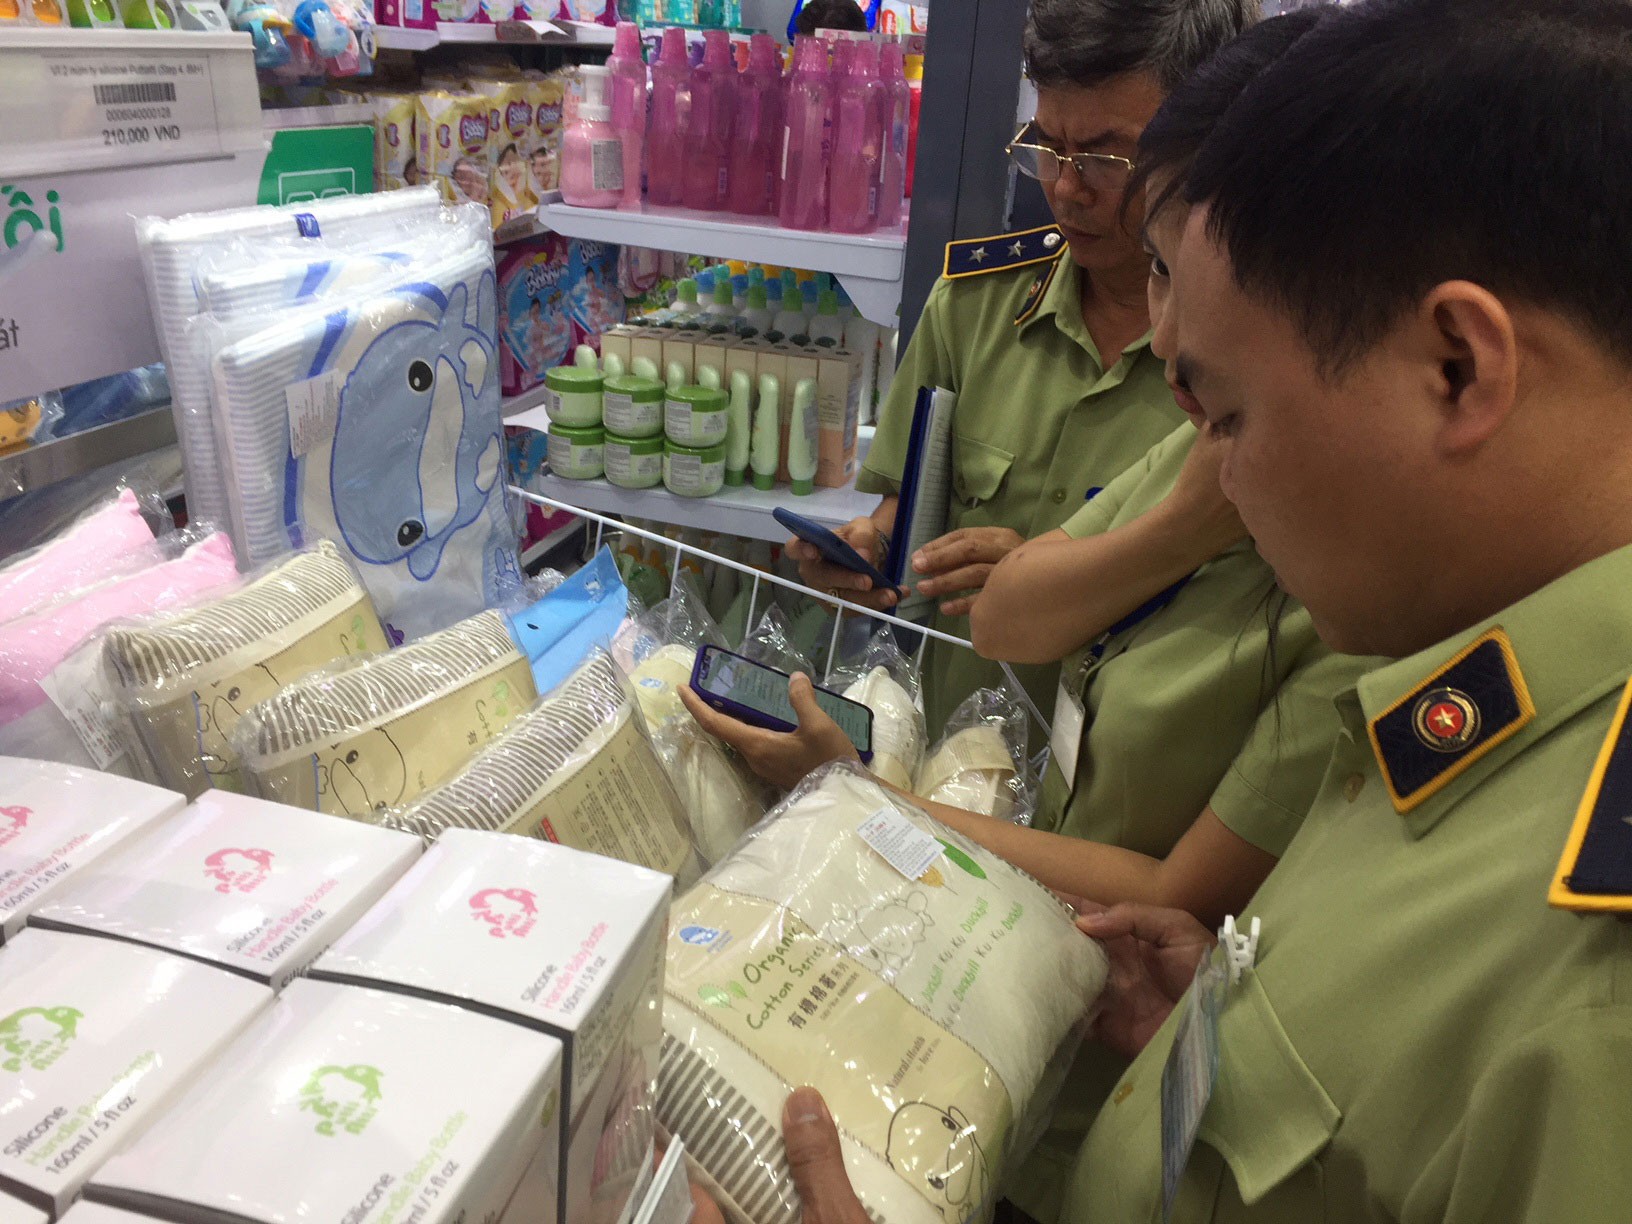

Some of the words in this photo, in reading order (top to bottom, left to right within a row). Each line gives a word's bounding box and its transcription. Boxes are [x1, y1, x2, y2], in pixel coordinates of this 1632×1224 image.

[102, 126, 149, 146] 210,000
[154, 124, 181, 141] VND
[476, 699, 493, 738] Cott
[56, 861, 71, 873] oz
[311, 908, 327, 921] oz
[226, 916, 273, 953] Silicone
[244, 923, 287, 958] Handle
[743, 925, 804, 985] Organic
[521, 964, 558, 1002] Silicone
[746, 982, 794, 1030] Cotton
[788, 945, 826, 977] Series
[3, 1105, 68, 1158] Silicone
[45, 1134, 93, 1174] 160ml
[94, 1119, 110, 1132] 5
[104, 1108, 121, 1122] fl
[117, 1095, 138, 1111] oz
[442, 1159, 460, 1177] oz
